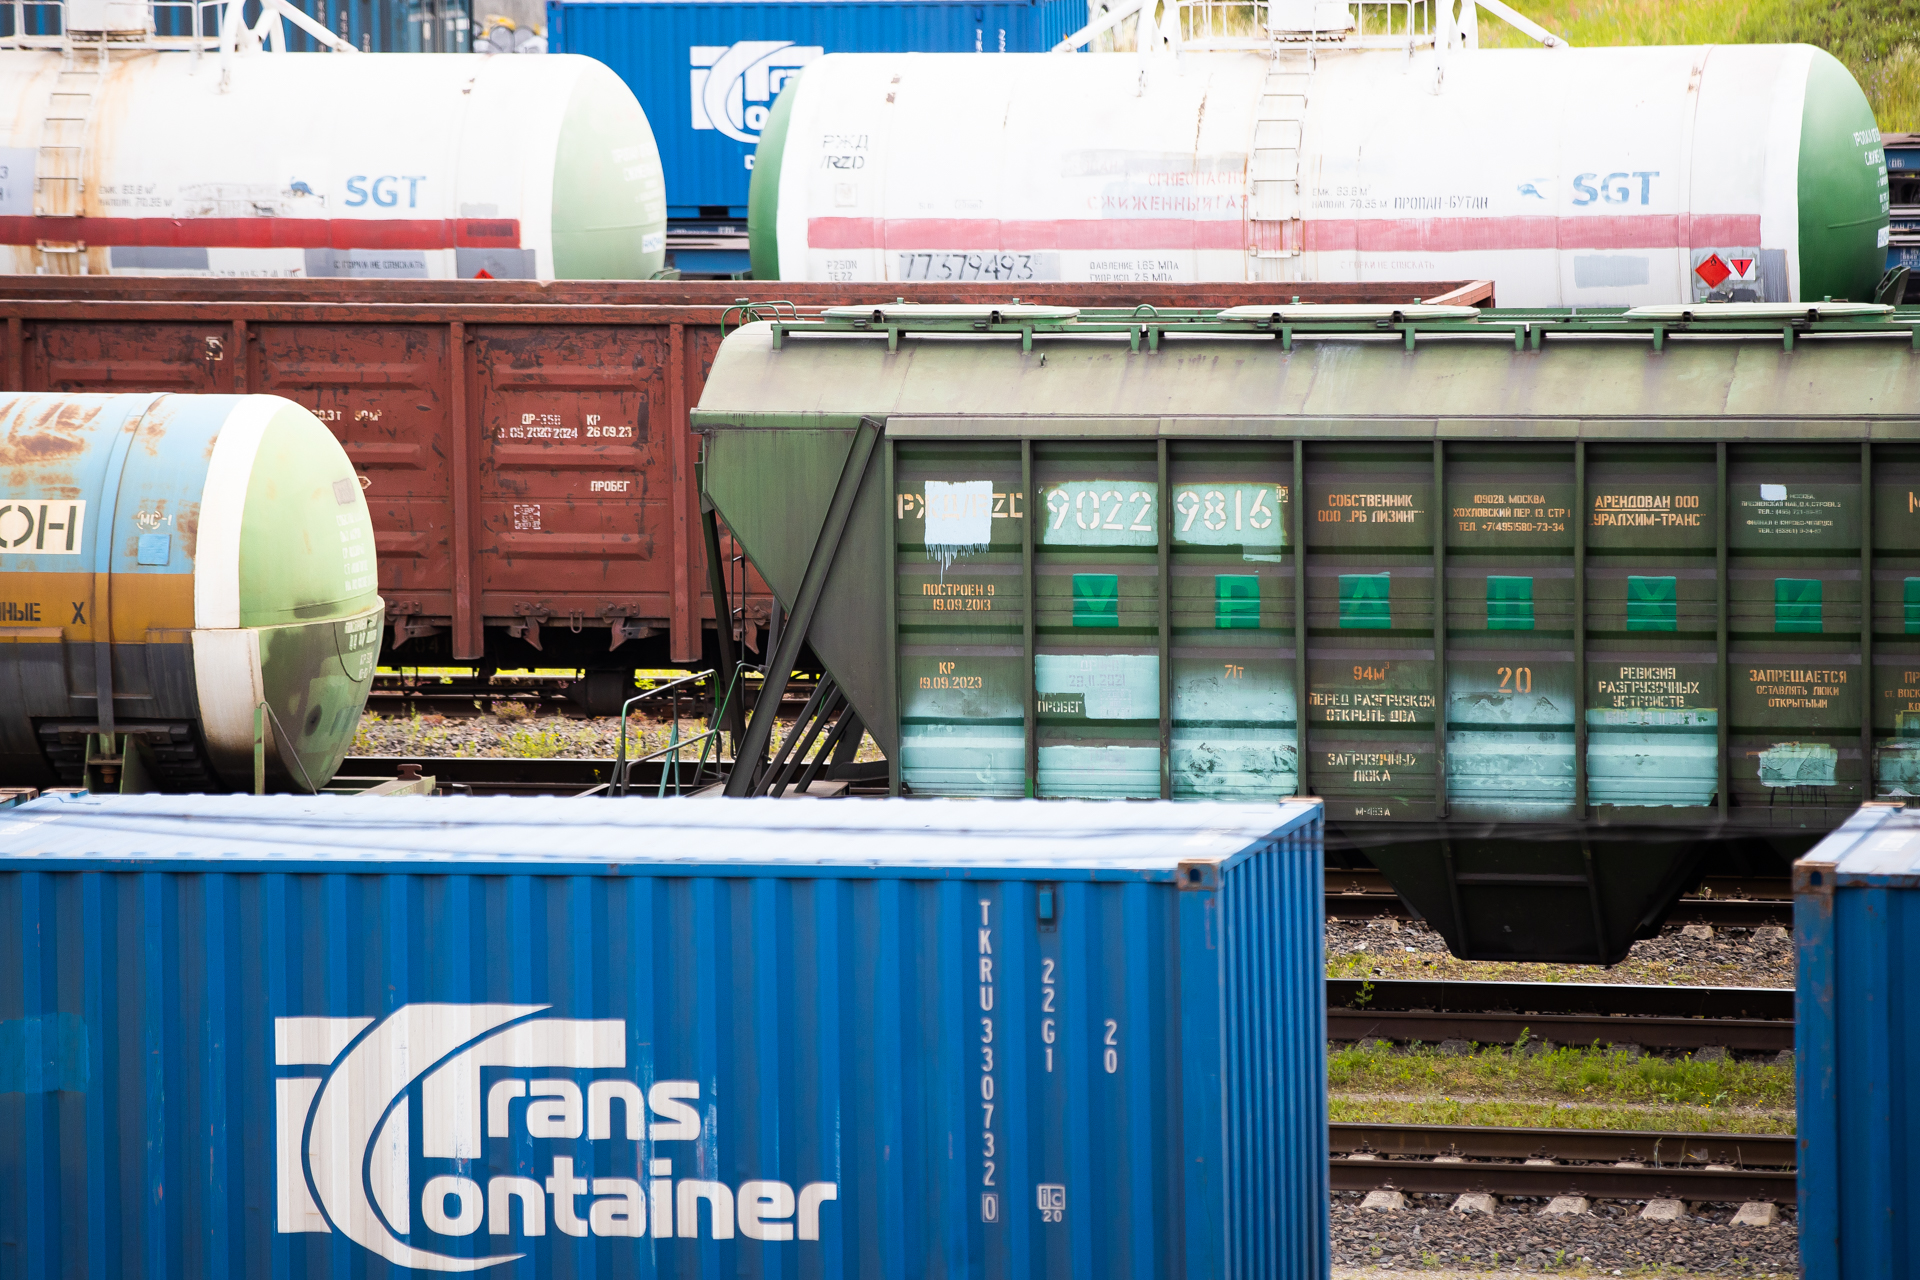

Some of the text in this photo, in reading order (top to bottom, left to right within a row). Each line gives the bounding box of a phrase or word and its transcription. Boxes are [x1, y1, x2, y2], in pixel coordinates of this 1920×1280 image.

[1148, 172, 1247, 186] ОГНЕОПАСНО
[344, 175, 427, 208] SGT
[1571, 171, 1660, 206] SGT
[586, 414, 601, 426] КР
[586, 426, 633, 439] 26.09.23
[590, 480, 631, 492] ПРОБЕГ
[1329, 494, 1413, 507] СОБСТВЕННИК
[1509, 495, 1545, 504] МОСКВА
[1595, 496, 1699, 510] АРЕНДОВАН ООО
[1047, 489, 1153, 532] 9022
[1176, 489, 1272, 532] 9816
[1318, 510, 1341, 522] ООО
[1453, 507, 1512, 518] ХОХЛОВСКИЙ
[1514, 508, 1533, 518] ПЕР.
[1548, 508, 1565, 518] СТР
[1459, 522, 1478, 532] ТЕЛ.
[923, 583, 995, 597] ПОСТРОЕН 9
[932, 599, 992, 612] 19.09.2013
[939, 661, 955, 675] КР
[1620, 667, 1676, 680] РЕВИЗИЯ
[919, 675, 983, 690] 19.09.2023
[1497, 667, 1532, 694] 20
[1749, 669, 1847, 684] ЗАПРЕЩАЕТСЯ
[1598, 681, 1700, 694] РАЗГРУЗОЧНЫХ
[1756, 685, 1840, 696] ОСТАВЛЯТЬ ЛЮКИ
[1309, 692, 1349, 706] ПЕРЕД
[1768, 698, 1828, 709] ОТКРЫТЫМИ
[1037, 699, 1083, 714] ПРОБЕГ
[1326, 709, 1416, 722] ОТКРЫТЬ ДВА
[1327, 753, 1417, 766] ЗАГРУЗОЧНЫХ
[1353, 770, 1391, 782] ЛЮКА
[1041, 958, 1056, 1074] 22G1
[1042, 1211, 1063, 1223] 20
